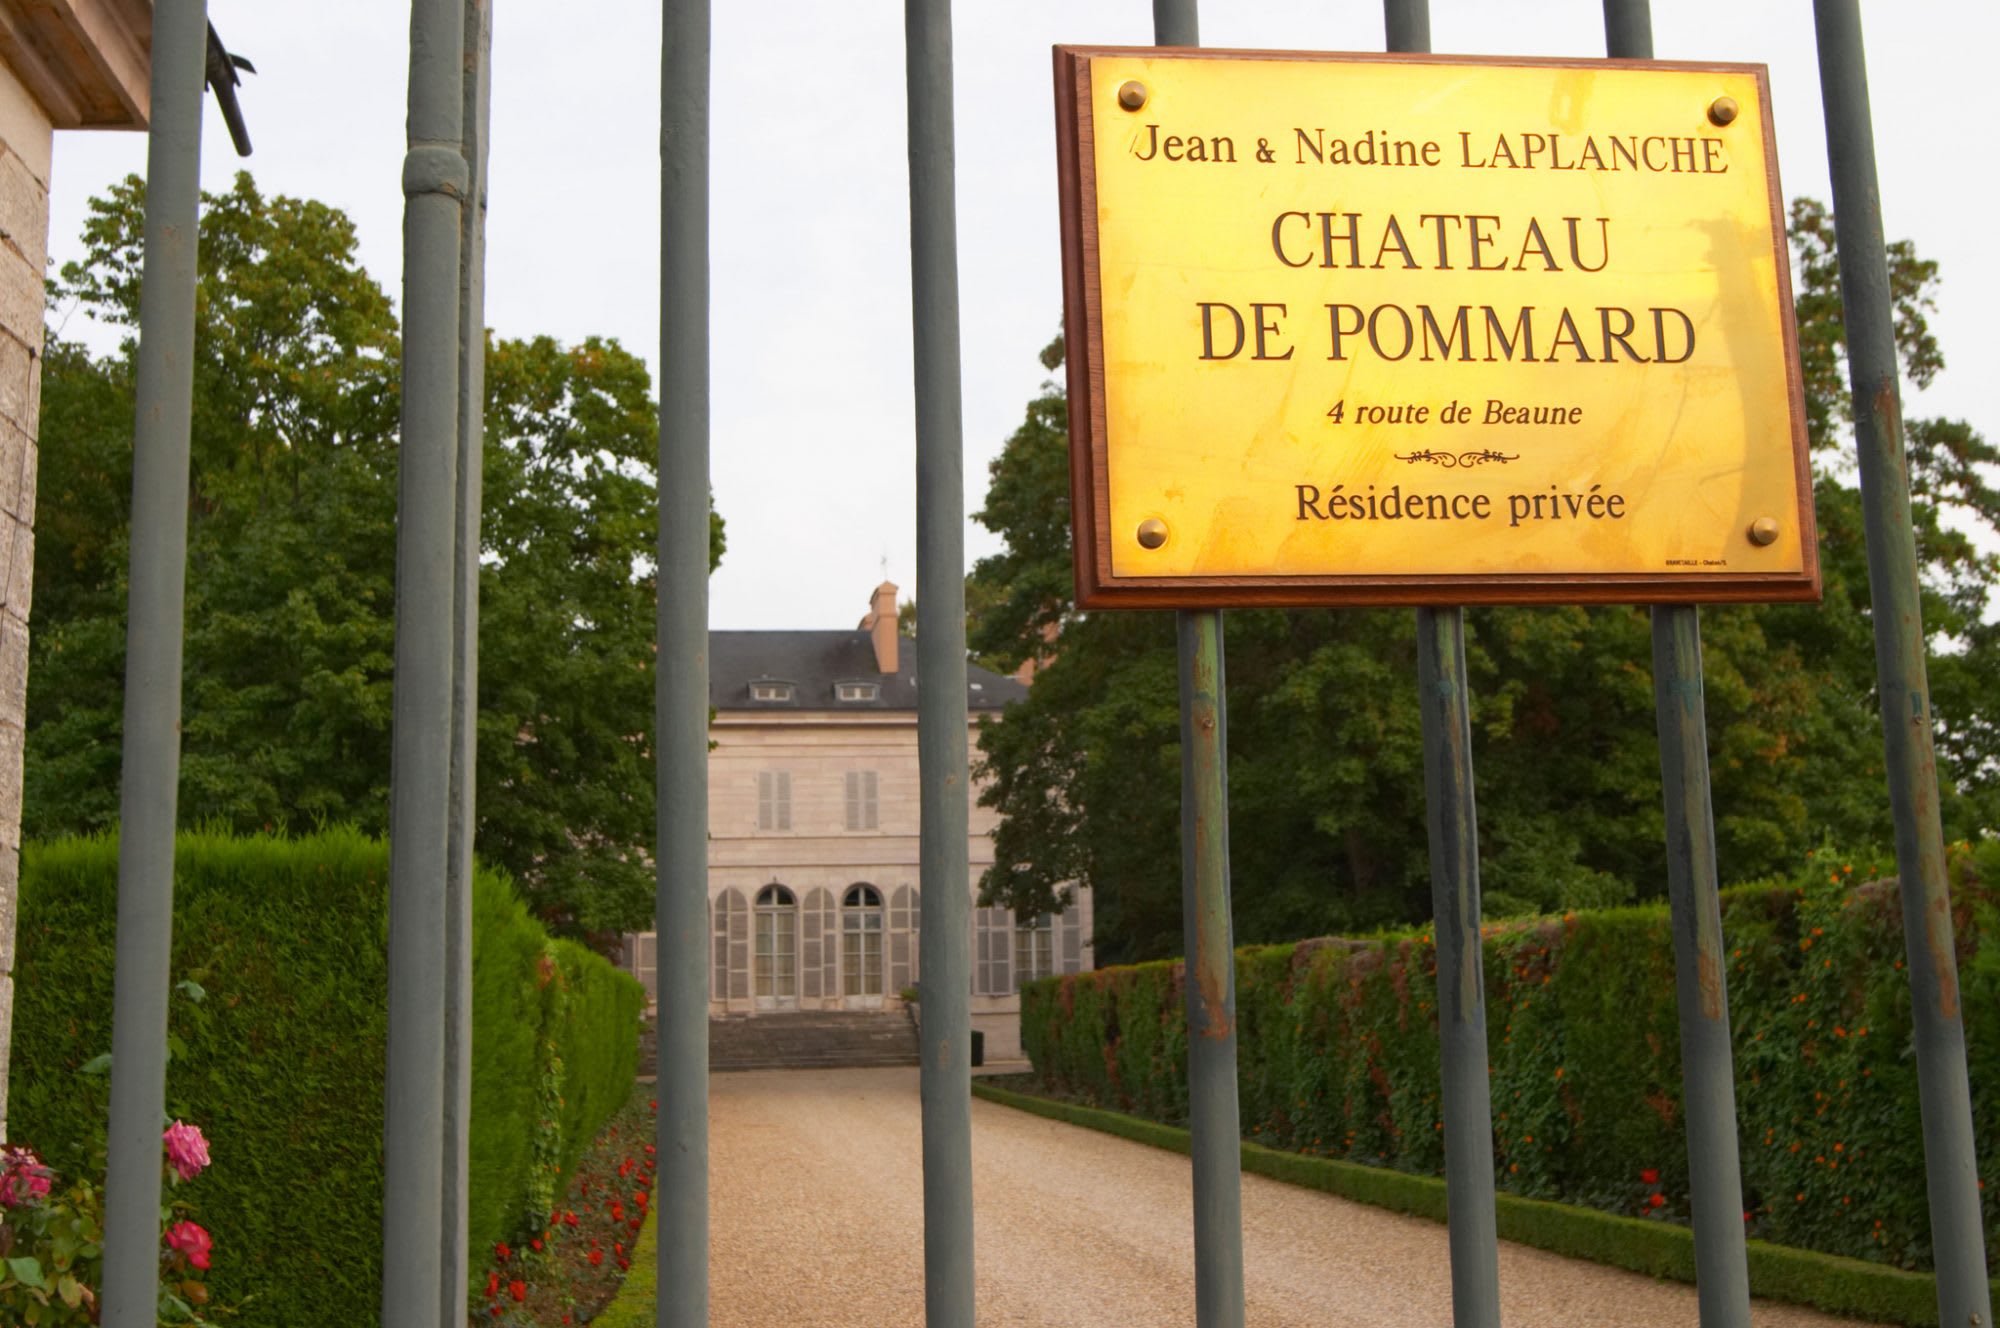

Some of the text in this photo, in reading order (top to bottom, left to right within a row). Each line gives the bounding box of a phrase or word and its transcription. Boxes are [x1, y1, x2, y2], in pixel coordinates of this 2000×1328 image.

[1134, 124, 1729, 174] Jean & Nadine LAPLANCHE
[1270, 210, 1611, 273] CHATEAU
[1195, 301, 1696, 365] DE POMMARD
[1325, 398, 1583, 426] 4 route de Beaune
[1294, 483, 1626, 528] Résidence privée
